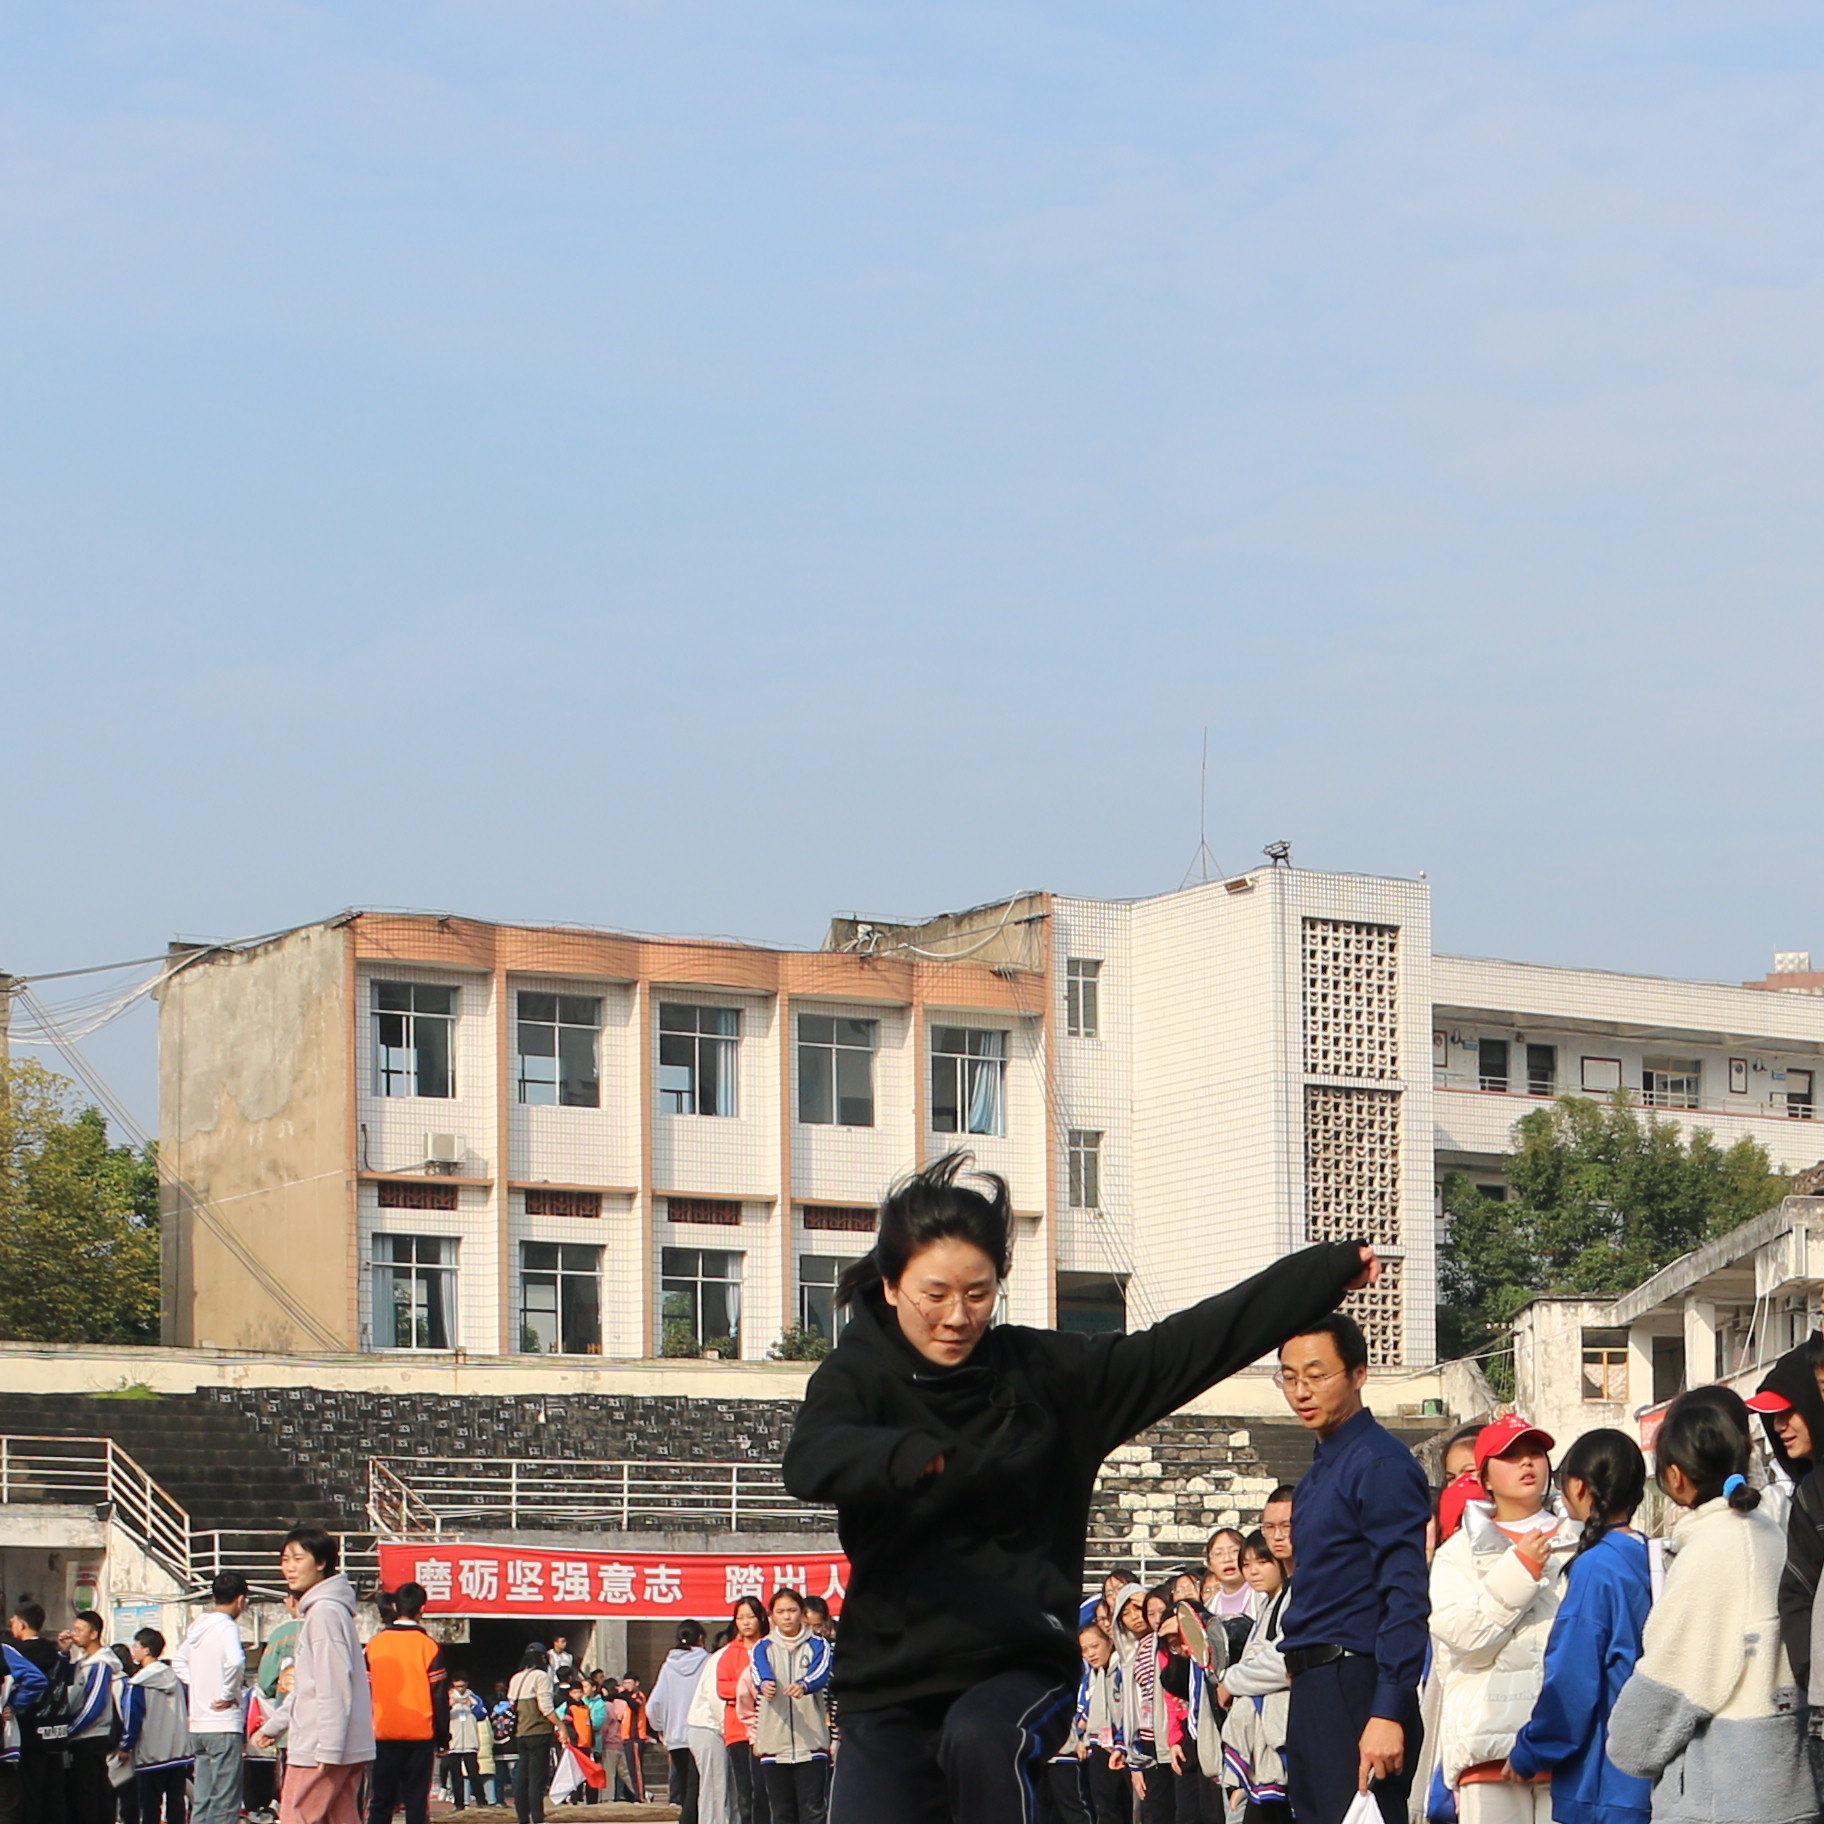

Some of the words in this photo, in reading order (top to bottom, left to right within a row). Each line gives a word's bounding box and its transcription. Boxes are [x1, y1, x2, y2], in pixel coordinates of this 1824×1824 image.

[414, 1557, 684, 1605] 磨砺坚强意志
